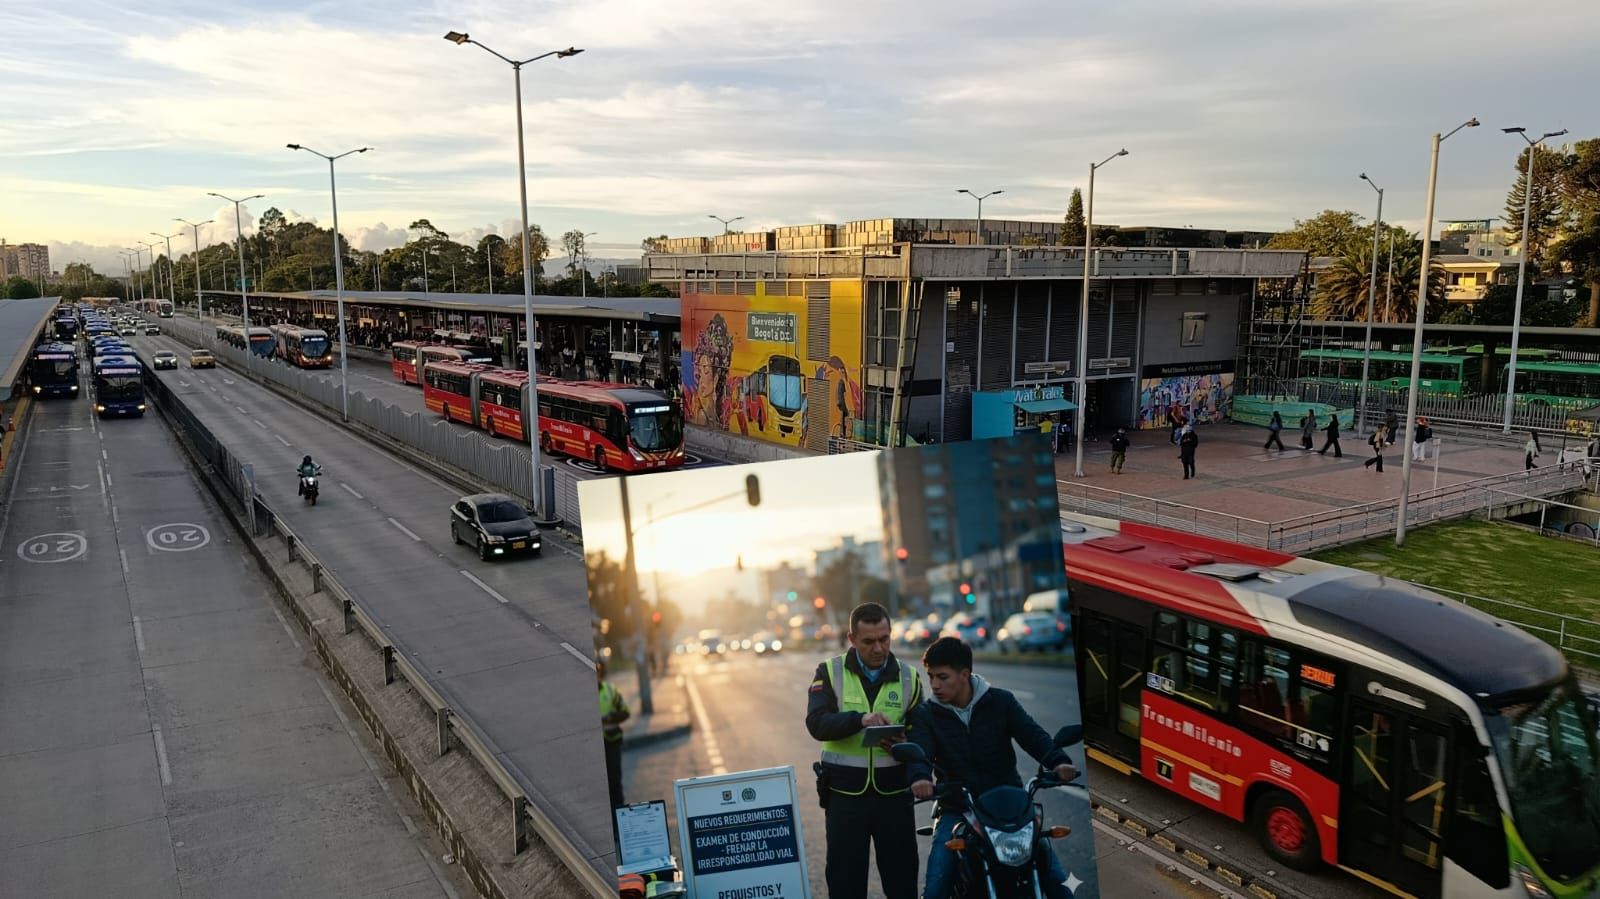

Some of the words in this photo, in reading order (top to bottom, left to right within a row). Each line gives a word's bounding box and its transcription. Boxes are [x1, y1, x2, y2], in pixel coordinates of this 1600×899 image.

[159, 529, 201, 544] 20
[28, 539, 77, 556] 20
[1142, 703, 1243, 758] TransMilenio
[694, 816, 723, 830] NUEVOS
[724, 808, 788, 825] REQUERIMIENTOS:
[695, 834, 728, 848] EXAMEN
[728, 833, 740, 843] DE
[740, 825, 790, 842] CONDUCCIÓN
[725, 841, 757, 855] FRENAR
[757, 840, 768, 850] LA
[697, 850, 776, 870] IRRESPONSABILIDAD
[775, 847, 794, 858] VIAL
[717, 884, 775, 899] REQUISITOS
[774, 882, 782, 895] Y
